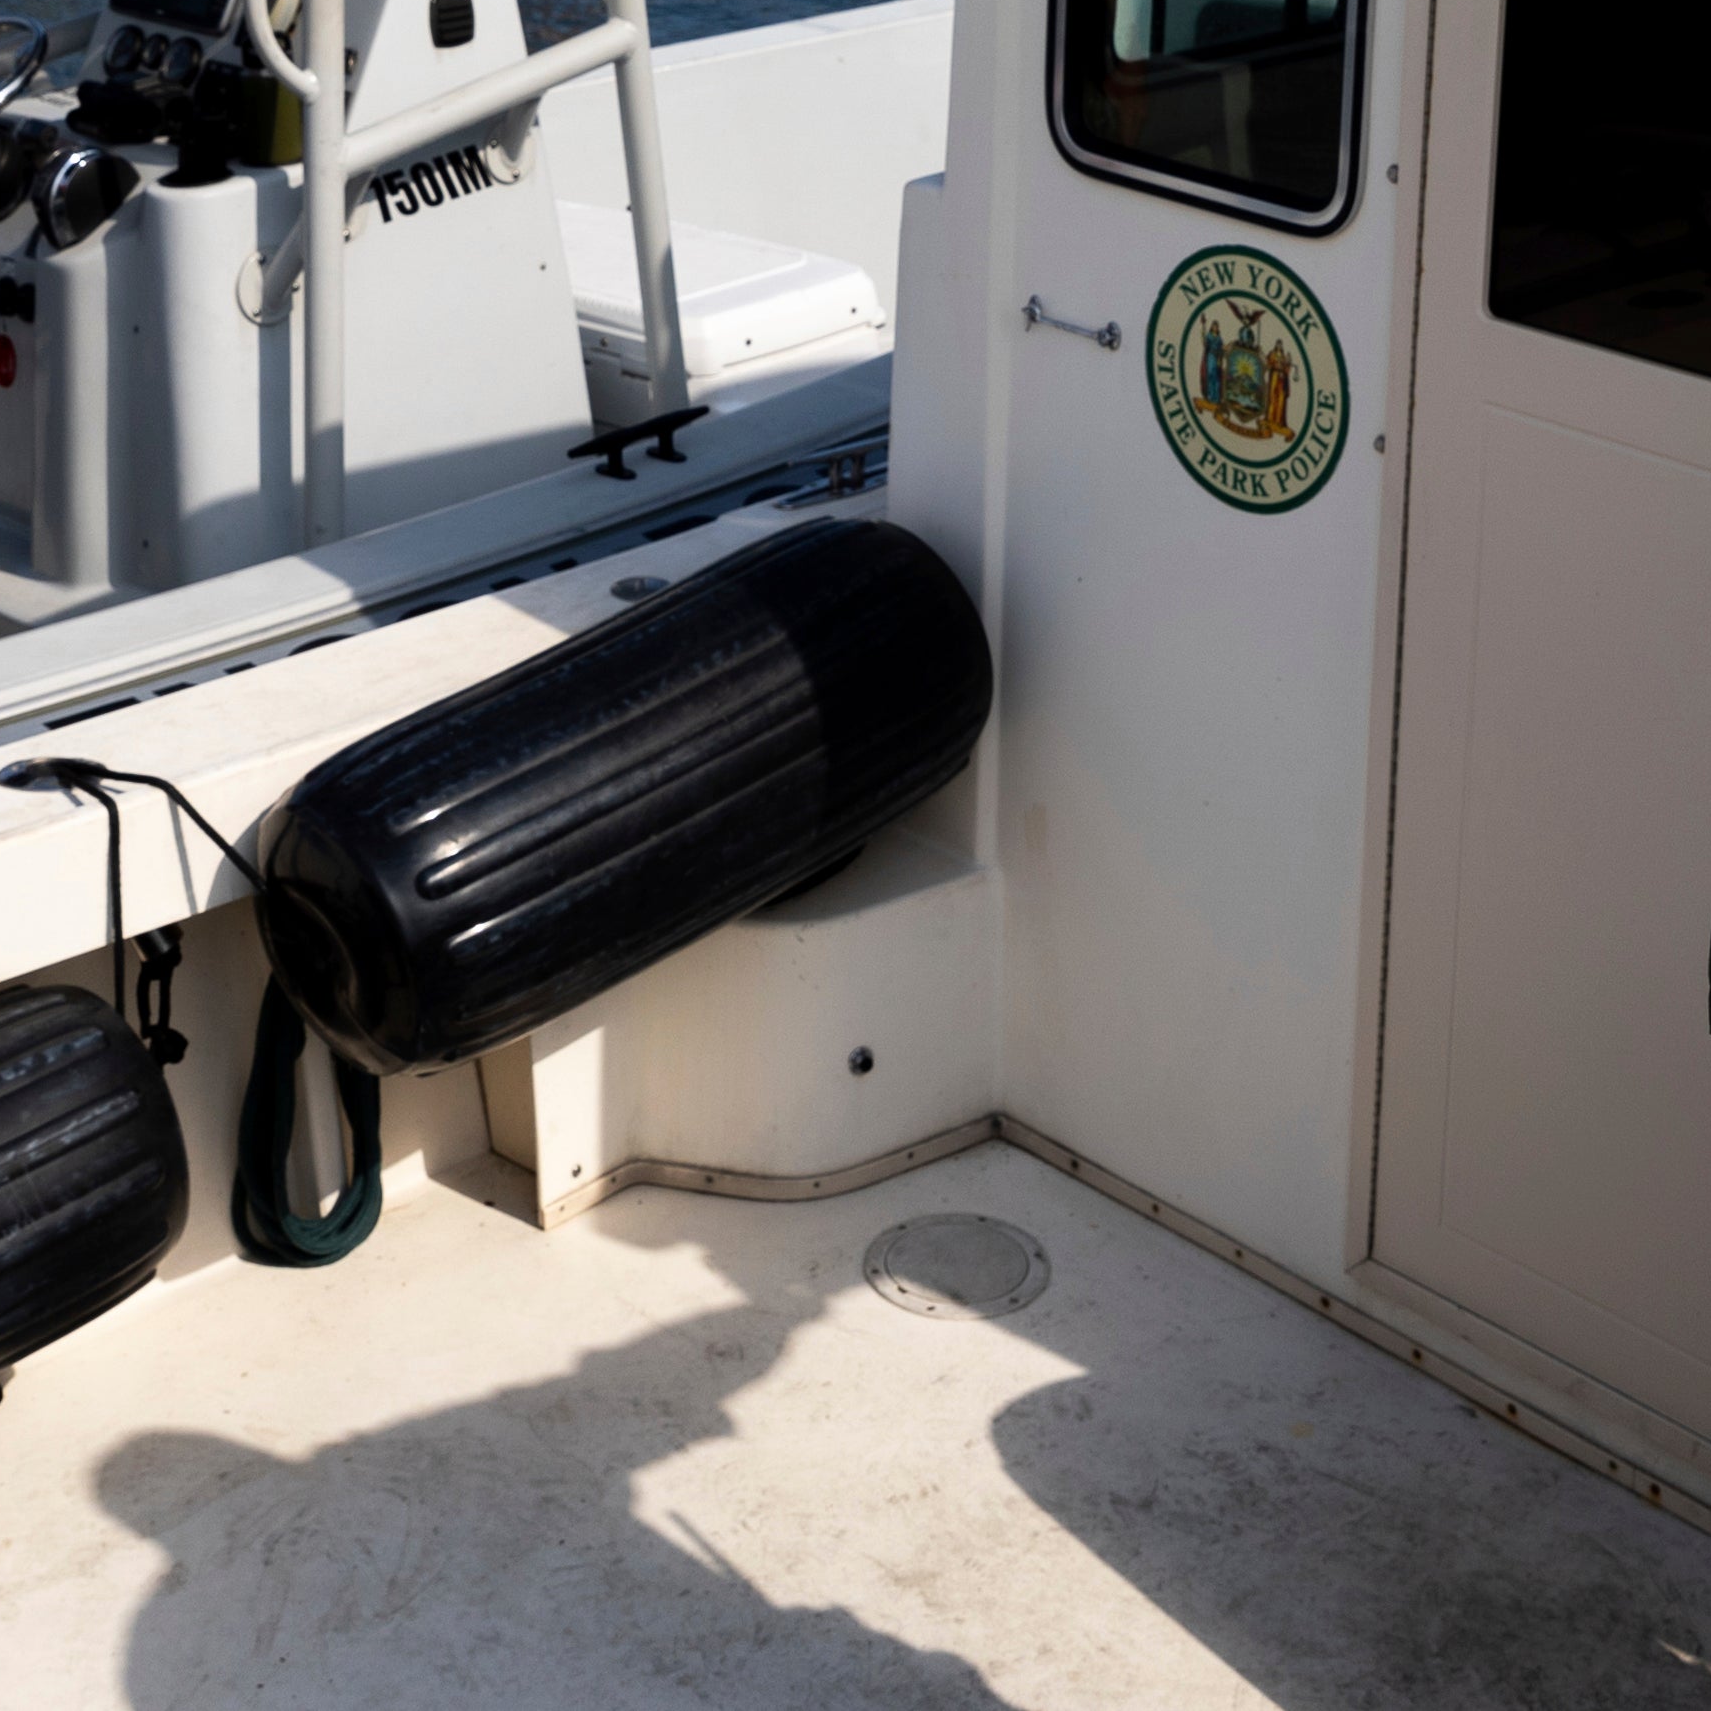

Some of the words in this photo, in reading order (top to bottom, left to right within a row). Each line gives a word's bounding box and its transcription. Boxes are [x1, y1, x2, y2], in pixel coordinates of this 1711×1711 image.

[1179, 261, 1236, 306] NEW
[1246, 263, 1321, 341] YORK
[1157, 340, 1197, 446] STATE
[1197, 447, 1269, 497] PARK
[1274, 388, 1337, 494] POLICE
